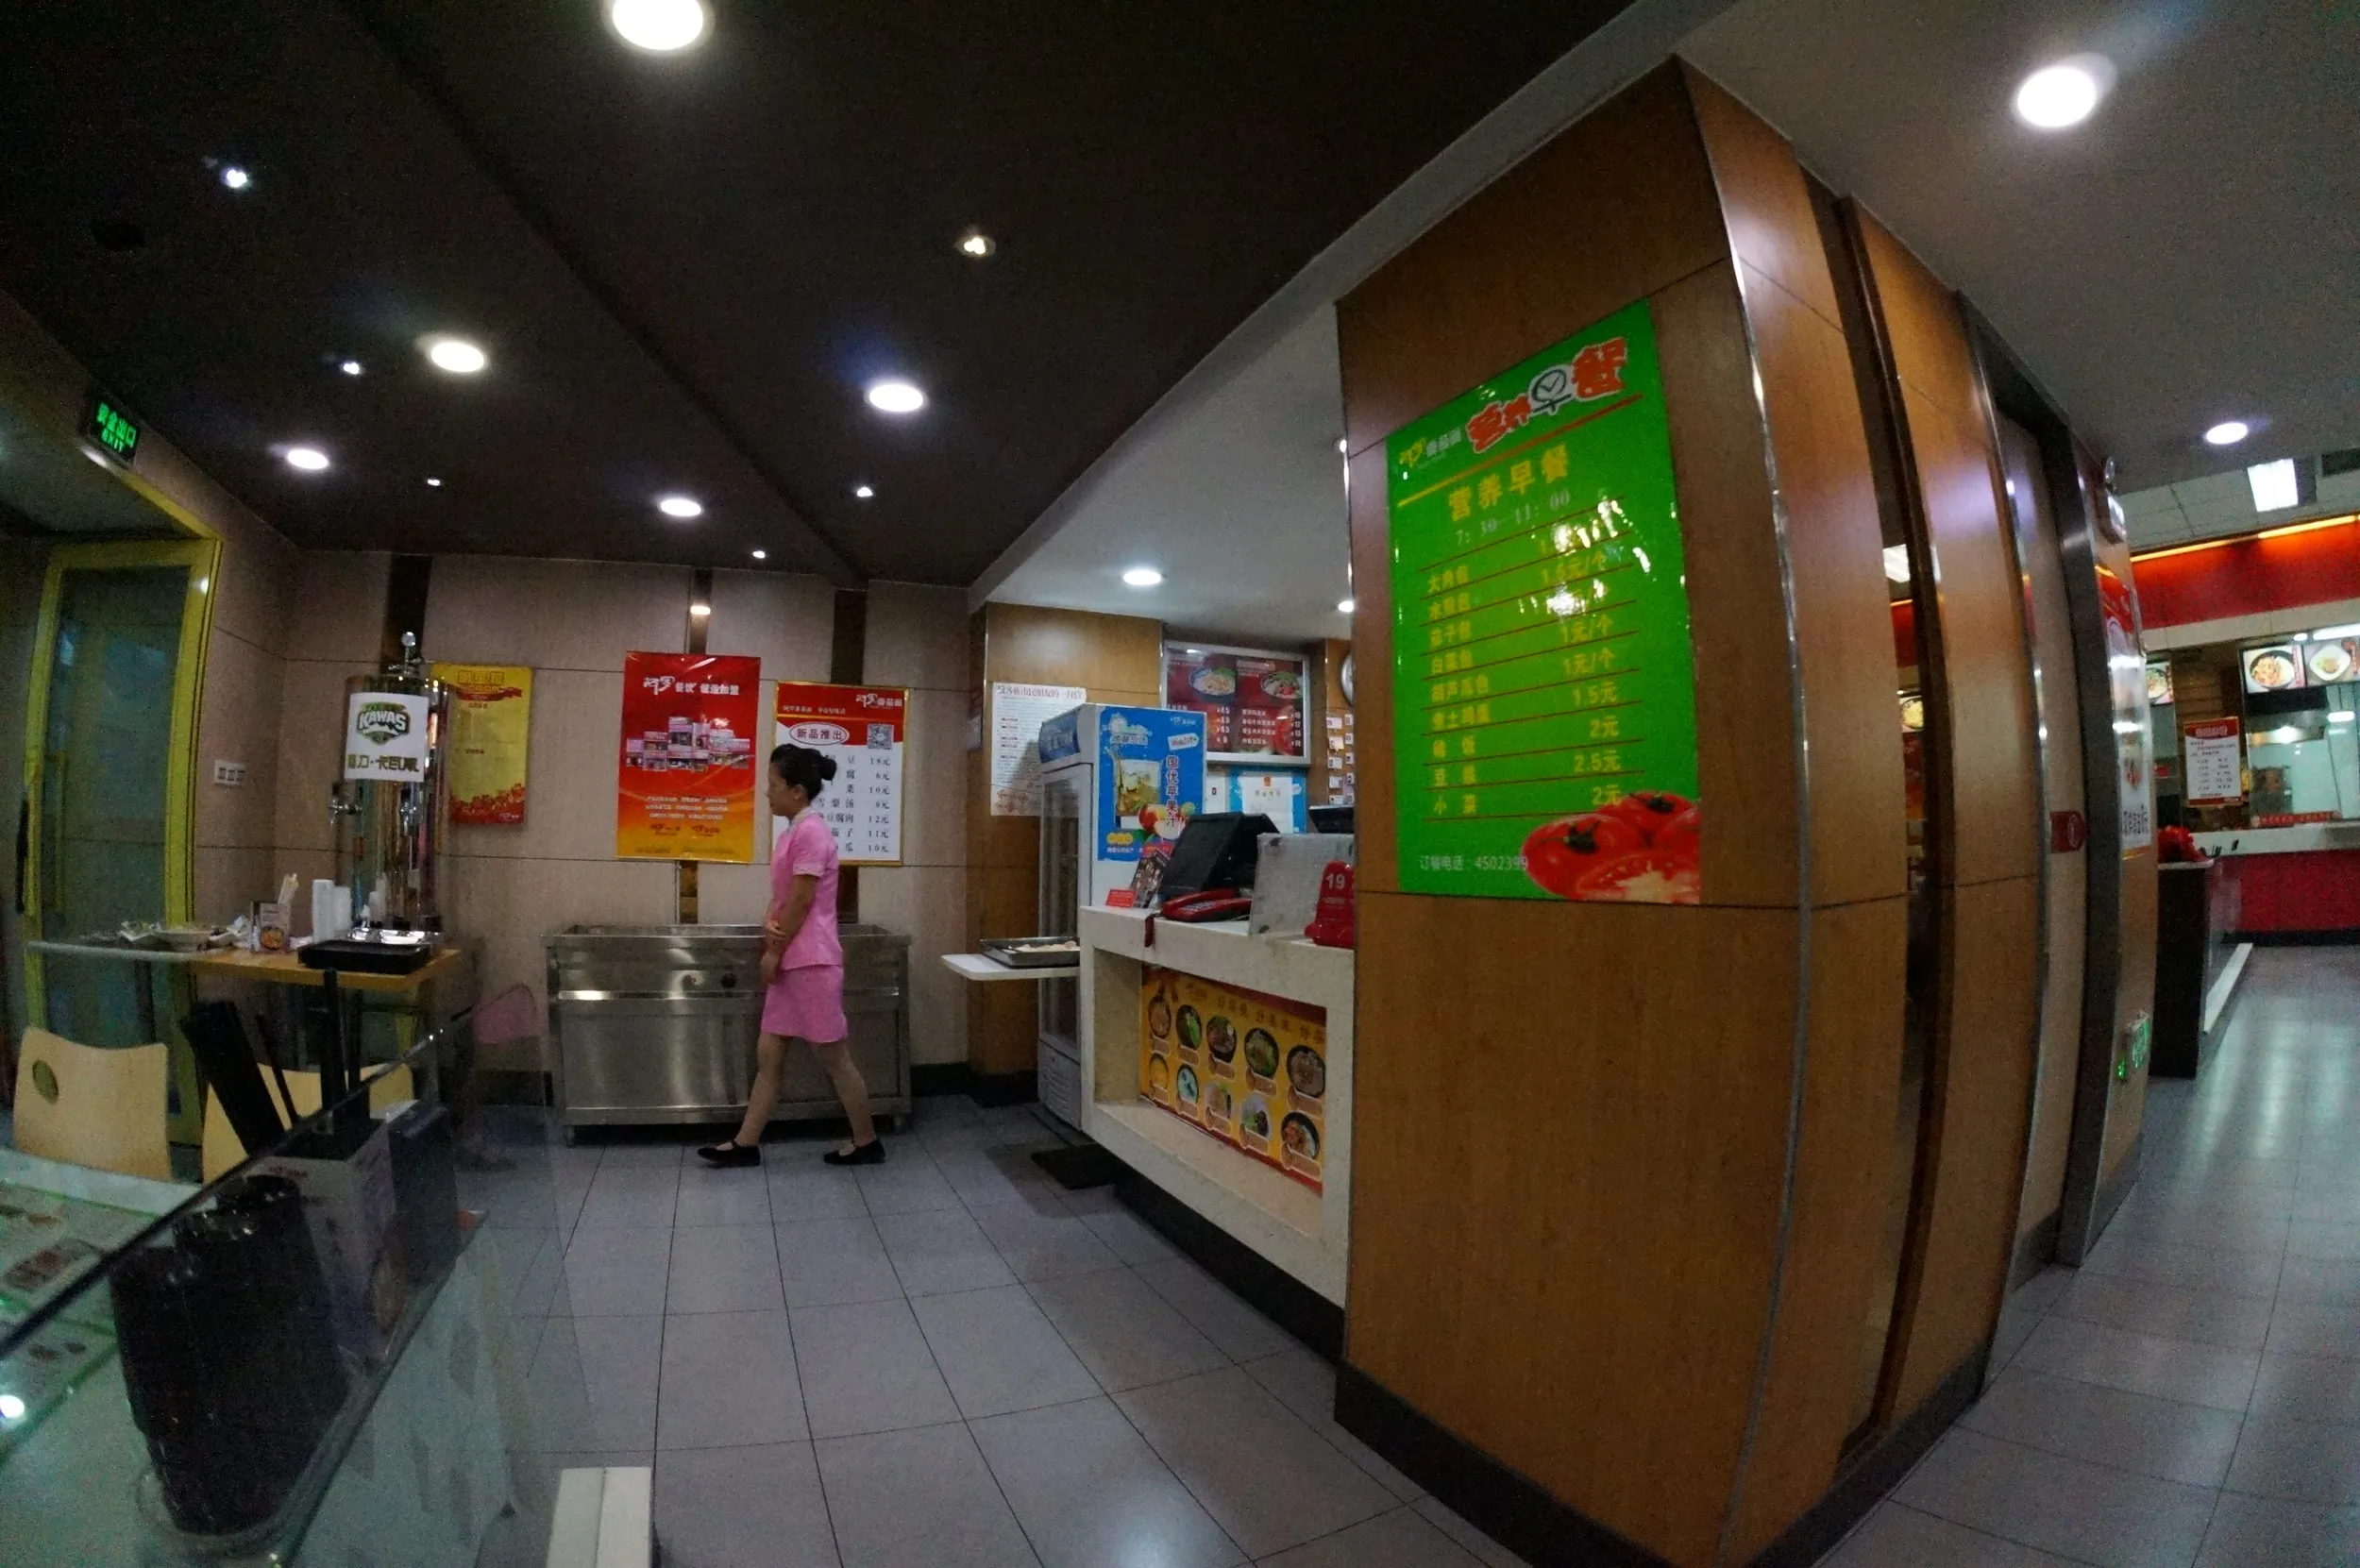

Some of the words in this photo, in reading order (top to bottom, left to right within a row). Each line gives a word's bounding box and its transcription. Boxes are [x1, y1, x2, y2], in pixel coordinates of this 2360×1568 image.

[1449, 444, 1568, 521] 营养早餐
[1573, 681, 1617, 705] 1.5元
[359, 710, 407, 731] KAWAS
[1590, 717, 1620, 738] 2元
[797, 728, 842, 740] 新品推出
[1574, 751, 1621, 774] 2.5元
[1593, 784, 1622, 806] 2元
[868, 815, 889, 824] 12元
[1325, 873, 1346, 889] 19
